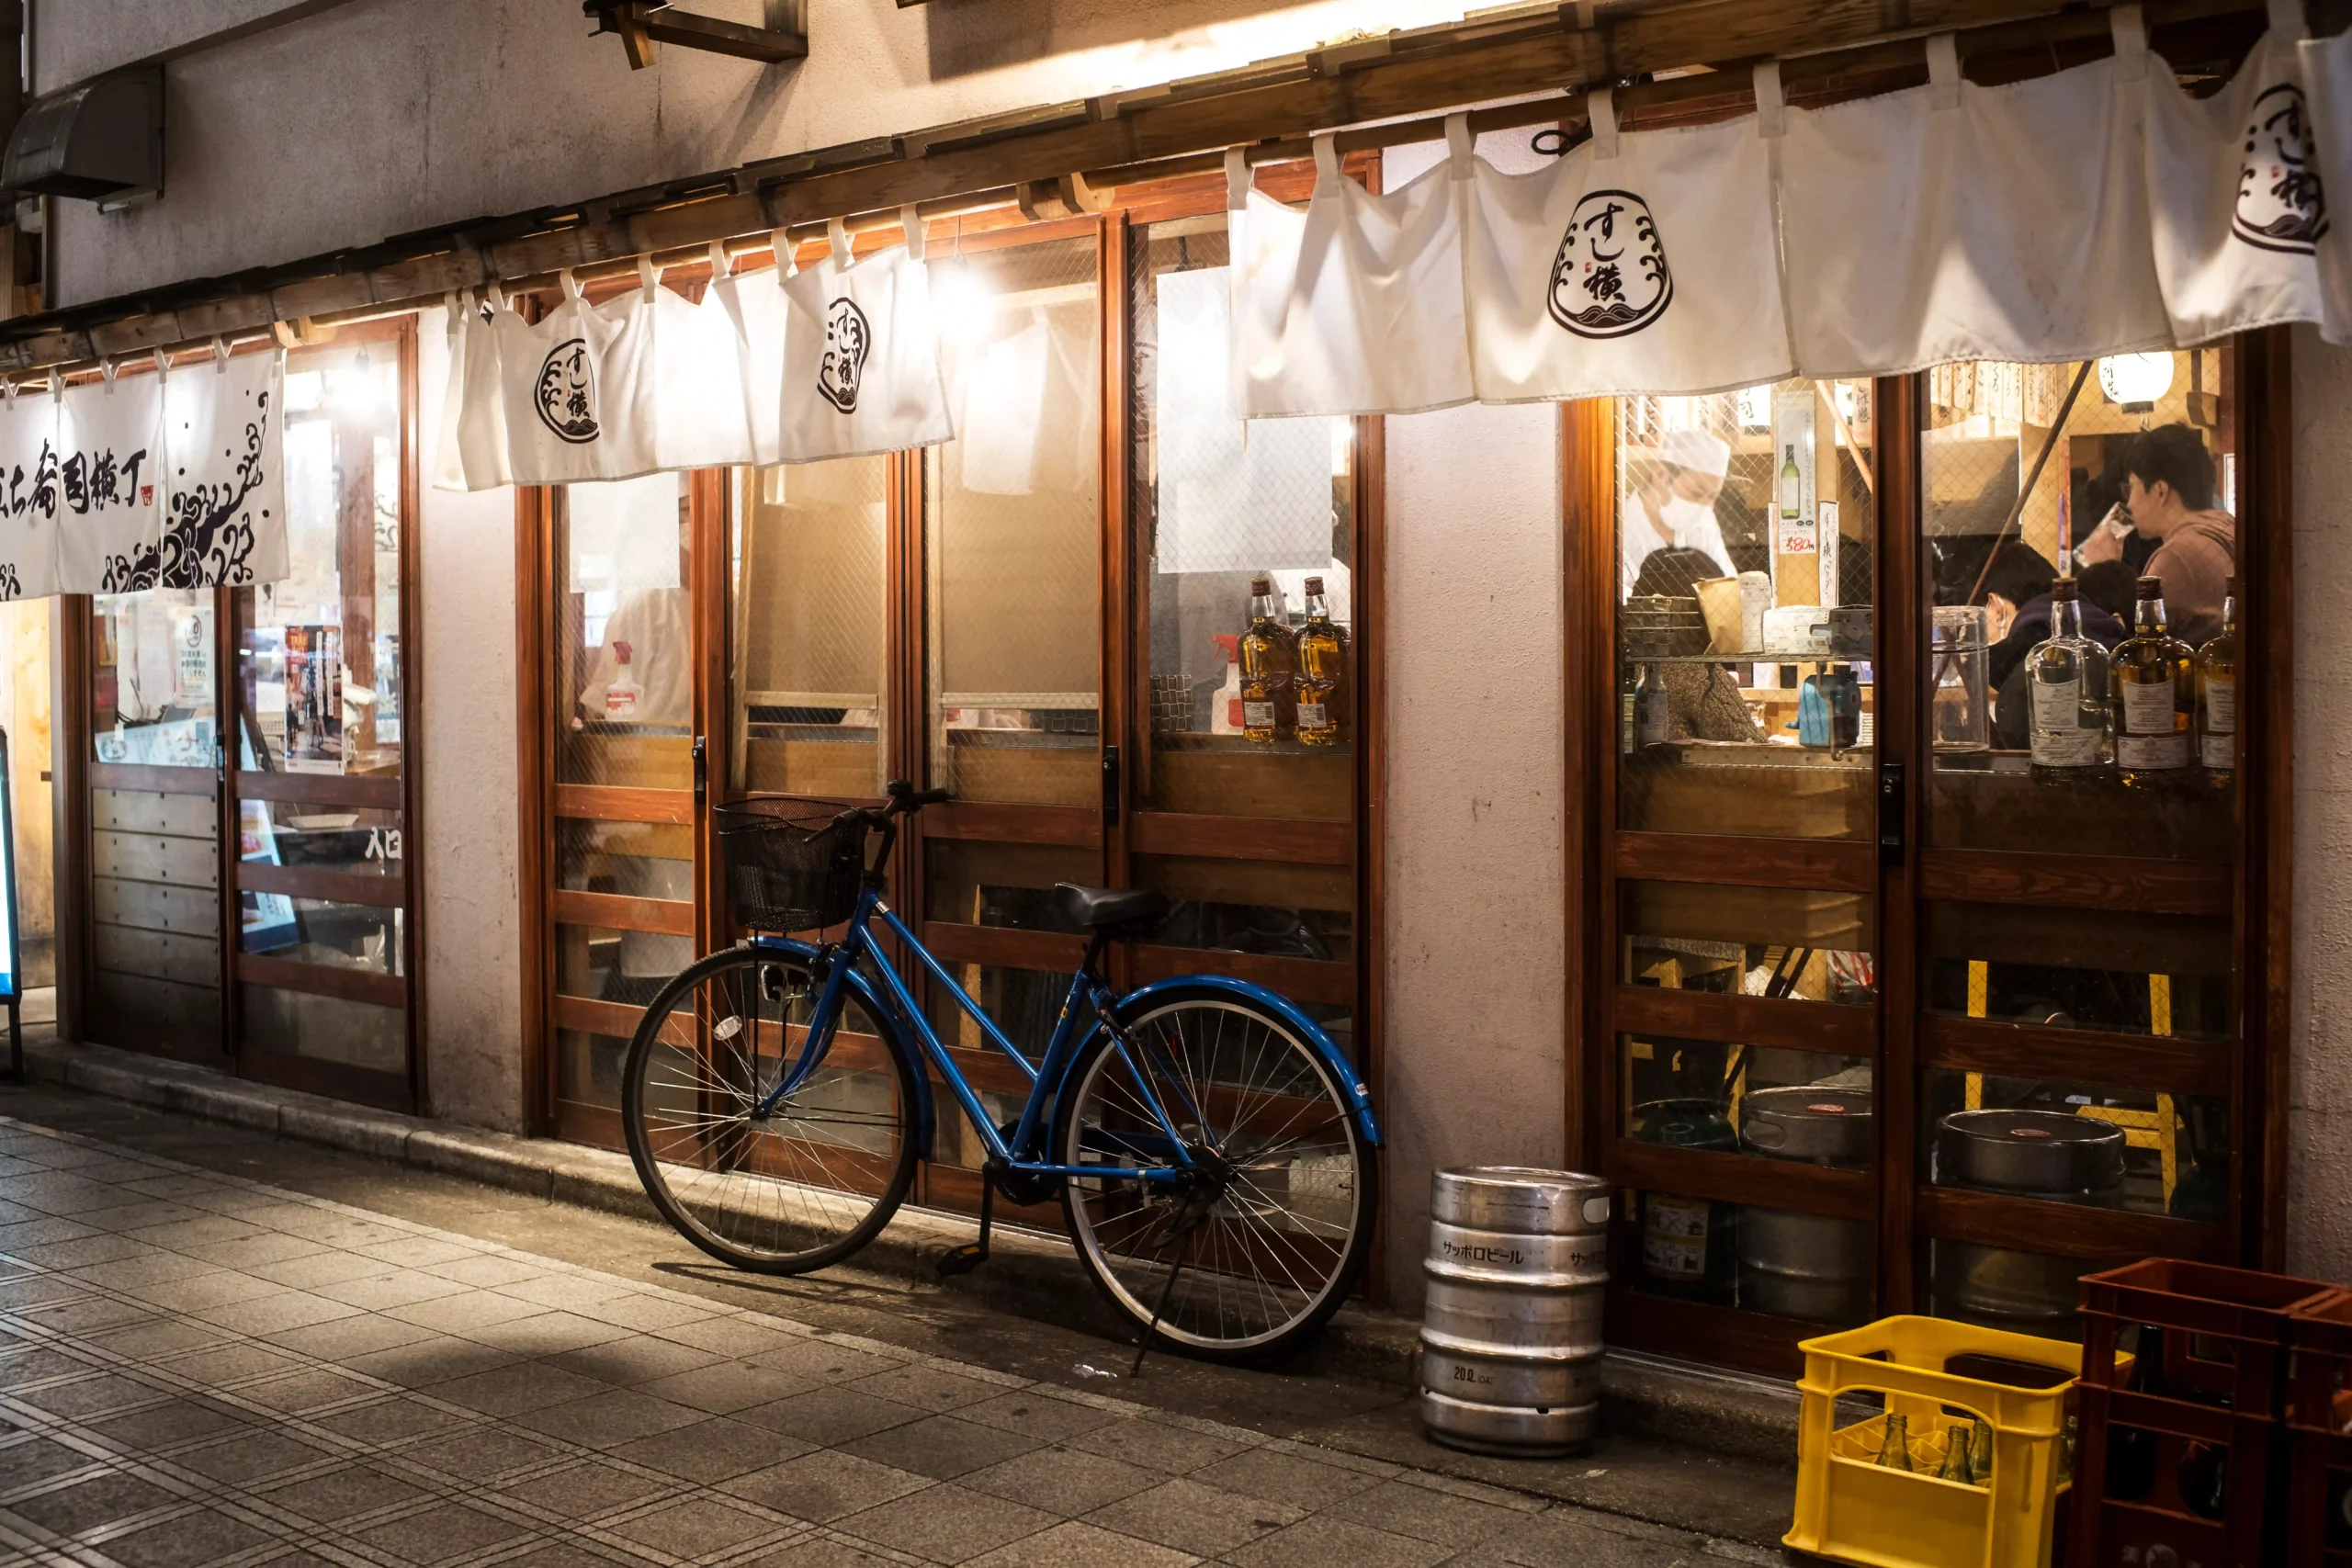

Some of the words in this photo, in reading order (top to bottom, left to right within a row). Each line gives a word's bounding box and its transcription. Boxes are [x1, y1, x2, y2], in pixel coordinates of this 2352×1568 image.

[1582, 201, 1626, 302] すし横
[565, 346, 591, 419] すし横
[836, 306, 854, 386] すし横
[365, 826, 402, 860] 入口
[1442, 1240, 1524, 1265] サッポロビール
